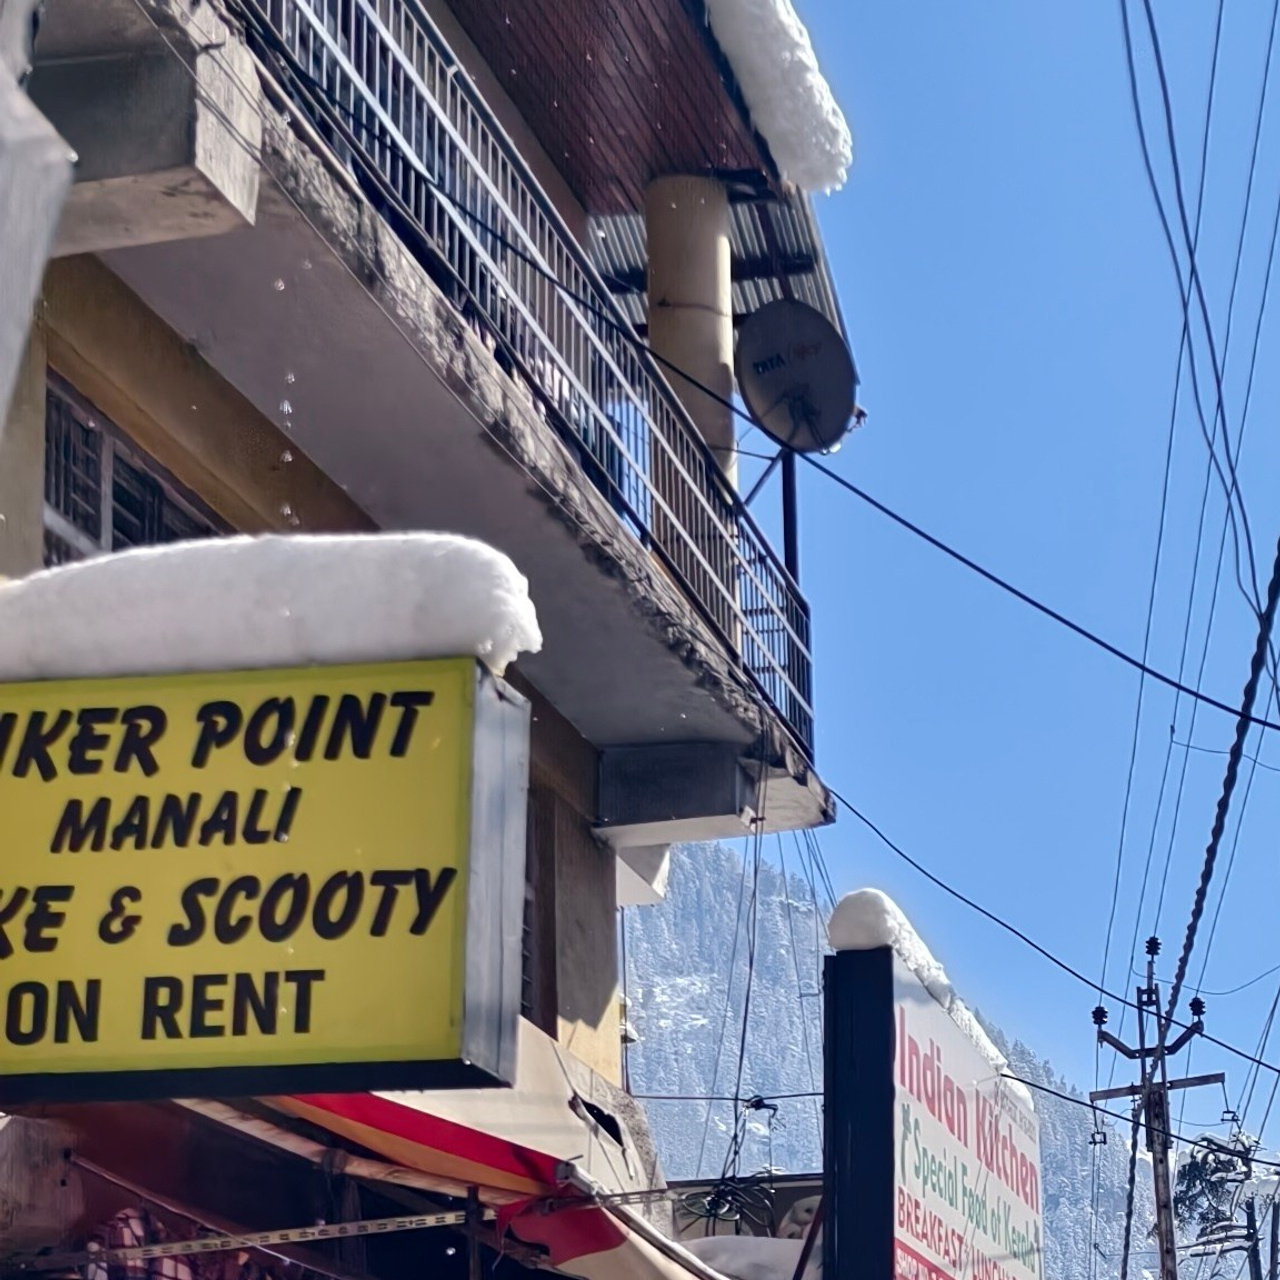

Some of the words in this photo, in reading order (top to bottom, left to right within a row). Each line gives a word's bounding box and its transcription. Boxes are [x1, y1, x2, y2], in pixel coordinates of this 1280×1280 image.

[192, 690, 435, 769] POINT
[50, 787, 303, 854] MANALI
[98, 886, 143, 944] &
[167, 867, 458, 947] SCOOTY
[5, 979, 103, 1046] ON
[141, 969, 326, 1041] RENT
[899, 1002, 968, 1149] Indian
[975, 1086, 1040, 1215] Kitchen
[897, 1185, 965, 1272] BREAKFAST
[913, 1117, 958, 1211] Special
[961, 1162, 988, 1236] Food
[991, 1196, 1002, 1246] of
[1003, 1199, 1036, 1274] Kerala
